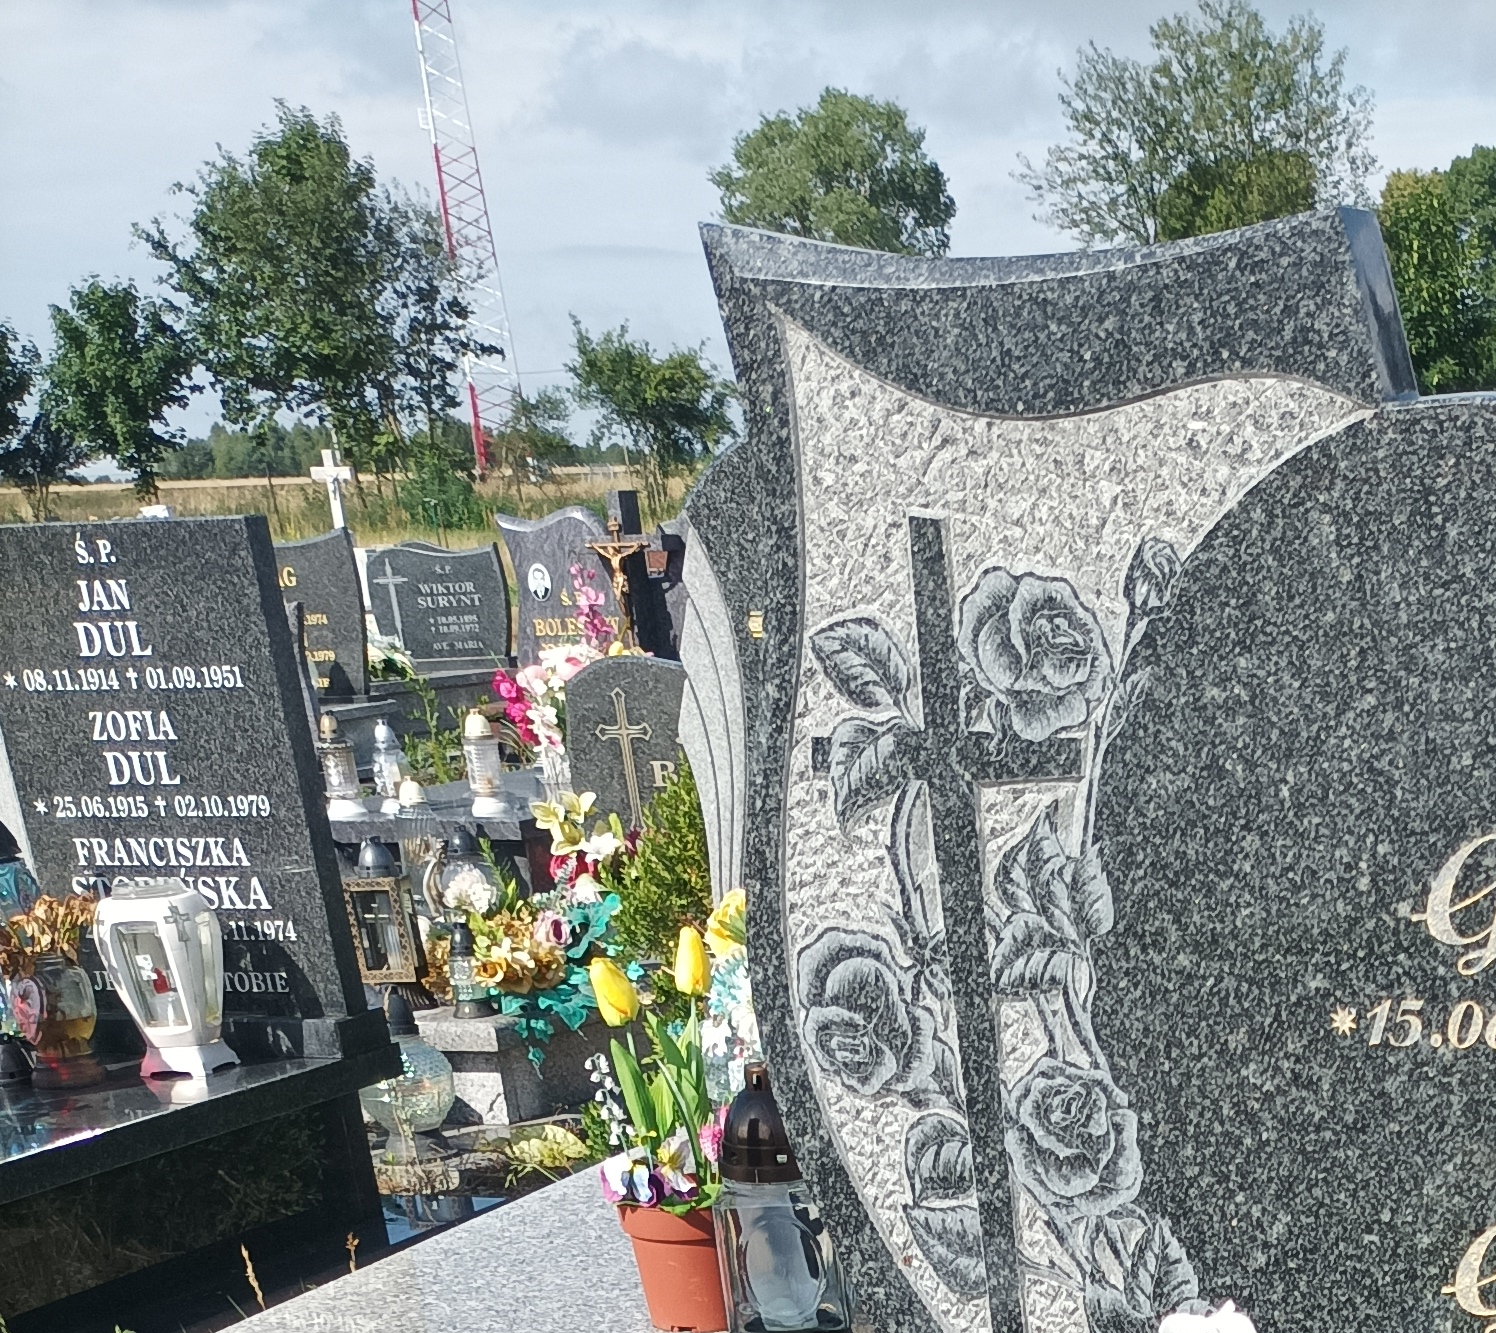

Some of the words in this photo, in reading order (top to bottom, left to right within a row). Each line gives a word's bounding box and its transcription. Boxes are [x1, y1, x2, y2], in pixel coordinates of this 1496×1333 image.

[76, 579, 131, 612] JAN
[417, 581, 477, 595] WIKTOR
[417, 594, 483, 609] SURYNT
[73, 621, 153, 658] DUL
[453, 640, 485, 650] MARIA
[23, 667, 120, 692] 08.11.1914
[145, 665, 245, 690] 01.09.1951
[88, 710, 178, 741] ZOFIA
[103, 750, 181, 786] DUL
[53, 795, 149, 818] 25.06.1915
[174, 794, 271, 817] 02.10.1979
[72, 836, 252, 868] FRANCISZKA
[223, 920, 298, 942] .11.1974
[223, 971, 290, 994] TOBIE
